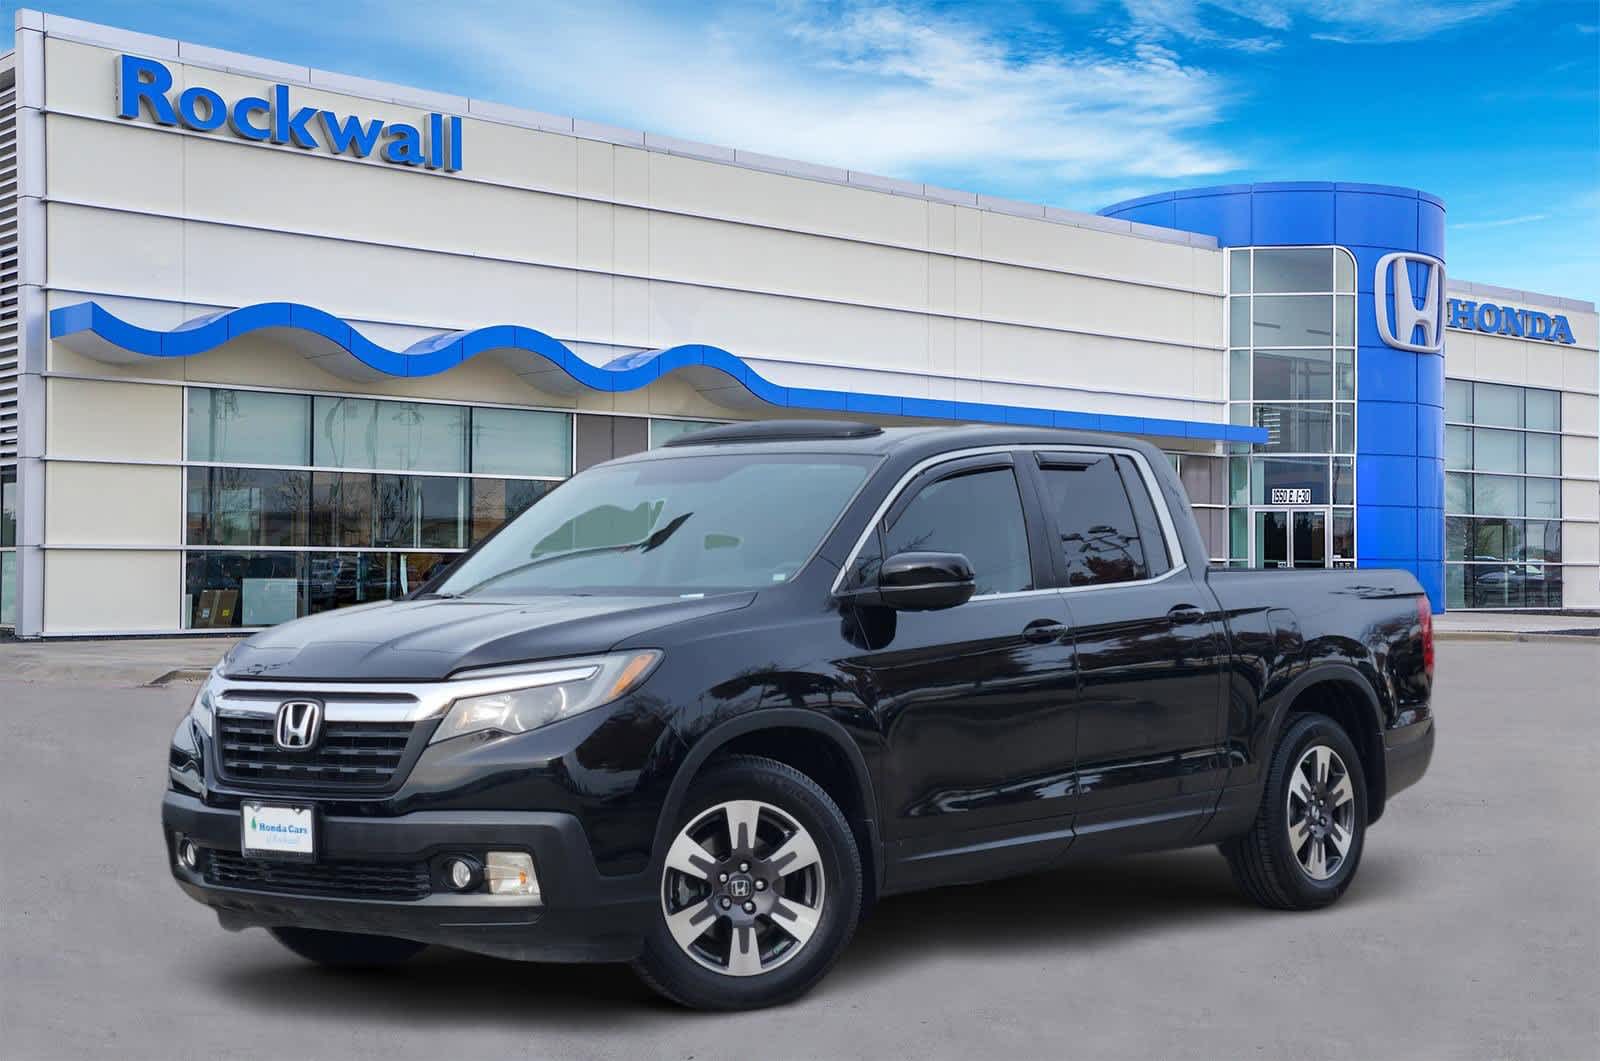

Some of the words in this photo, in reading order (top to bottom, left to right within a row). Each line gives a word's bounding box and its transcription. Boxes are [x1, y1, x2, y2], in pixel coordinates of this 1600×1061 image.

[117, 54, 463, 172] Rockwall
[1447, 298, 1576, 344] HONDA
[1273, 490, 1288, 503] 1550
[259, 822, 287, 833] Honda
[288, 824, 308, 835] Cars
